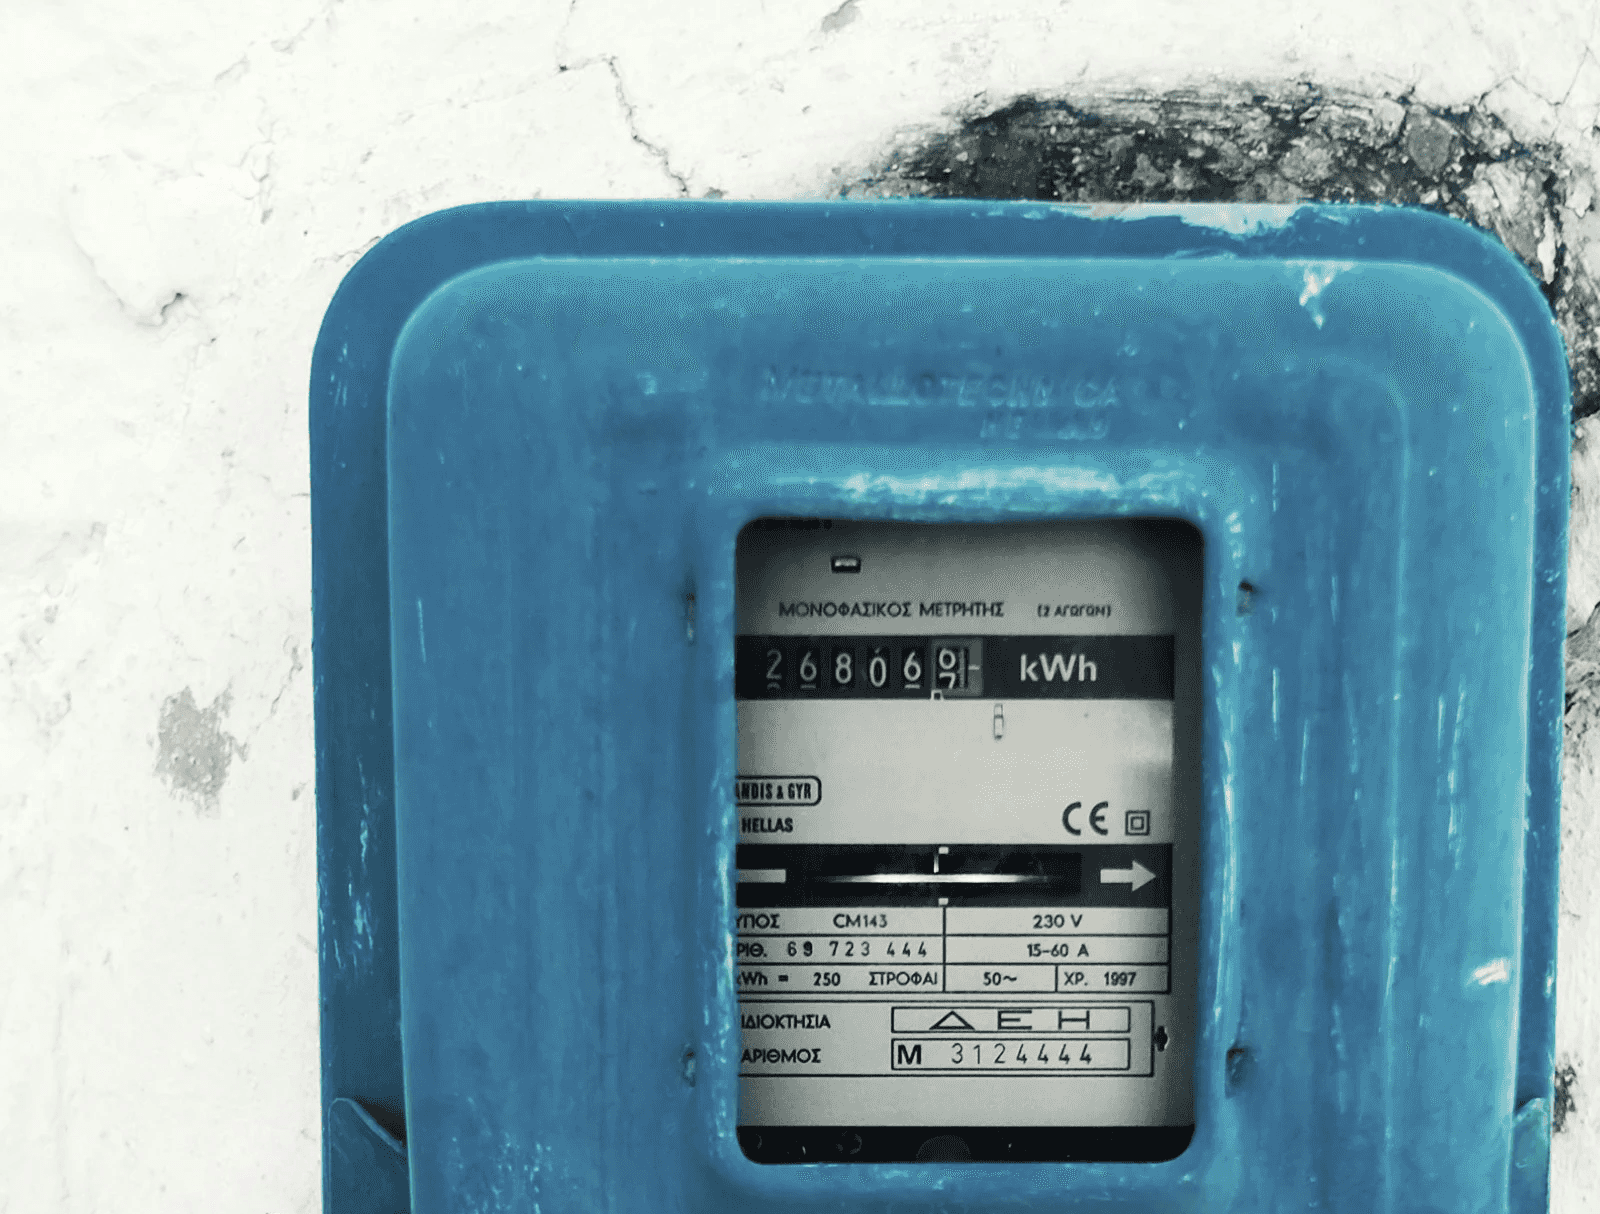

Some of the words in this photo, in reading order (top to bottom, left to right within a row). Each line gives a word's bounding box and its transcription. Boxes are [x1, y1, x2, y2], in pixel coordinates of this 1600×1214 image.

[780, 601, 911, 617] ΜΟΝΟΦΑΣΙΚΟΣ
[919, 602, 1003, 617] ΜΕΤΡΗΤΗΣ
[1021, 654, 1096, 681] kWh
[777, 785, 784, 799] &
[788, 783, 811, 799] GYR
[742, 817, 793, 833] HELLAS
[1062, 801, 1108, 835] CE
[833, 913, 887, 928] CM143
[1034, 914, 1065, 929] 230
[1071, 914, 1082, 927] V
[829, 940, 869, 957] 723
[887, 942, 926, 956] 444
[1027, 943, 1068, 957] 15-60
[1078, 944, 1089, 956] A
[814, 972, 840, 986] 250
[869, 971, 937, 986] ΣΤΡΟΦΑΙ
[1104, 972, 1136, 986] 1997
[928, 1009, 1091, 1031] ΔΕΗ
[742, 1048, 821, 1063] ΑΡΙΘΜΟΣ
[952, 1043, 1091, 1064] 3124444
